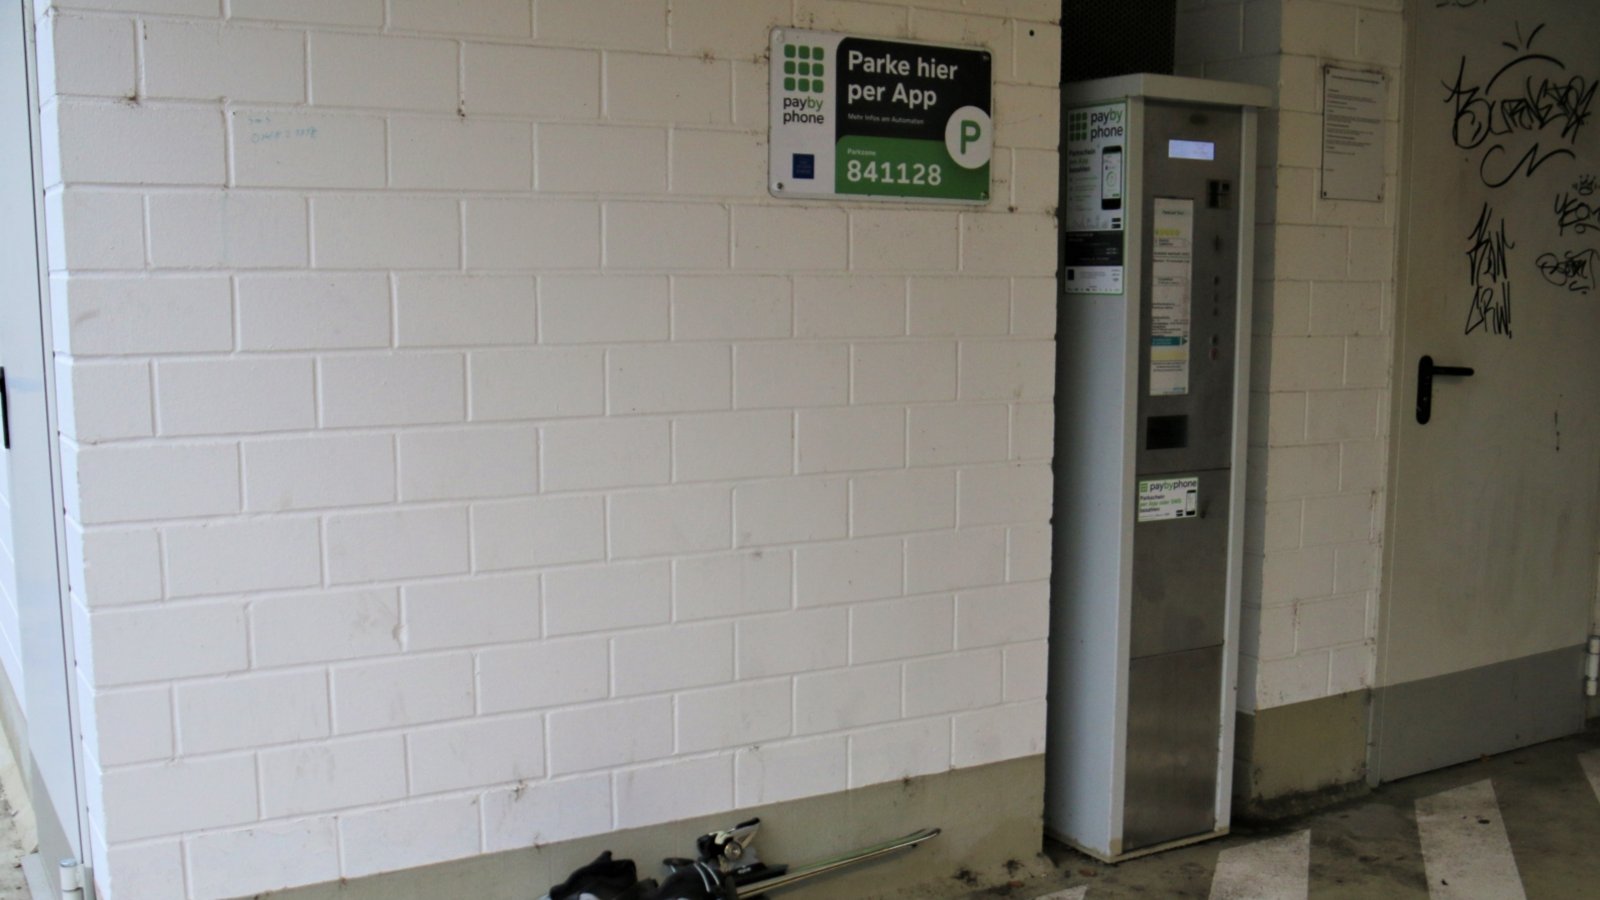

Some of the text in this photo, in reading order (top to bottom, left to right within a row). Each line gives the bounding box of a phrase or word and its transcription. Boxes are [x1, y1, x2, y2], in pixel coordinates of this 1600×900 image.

[848, 50, 958, 80] Parke hier
[848, 83, 937, 110] per App
[783, 110, 825, 125] phone
[864, 114, 880, 122] Infos
[891, 116, 925, 125] Automaten
[960, 119, 981, 155] P
[1090, 125, 1123, 142] phone
[847, 148, 877, 156] Parkzone
[847, 160, 942, 186] 841128
